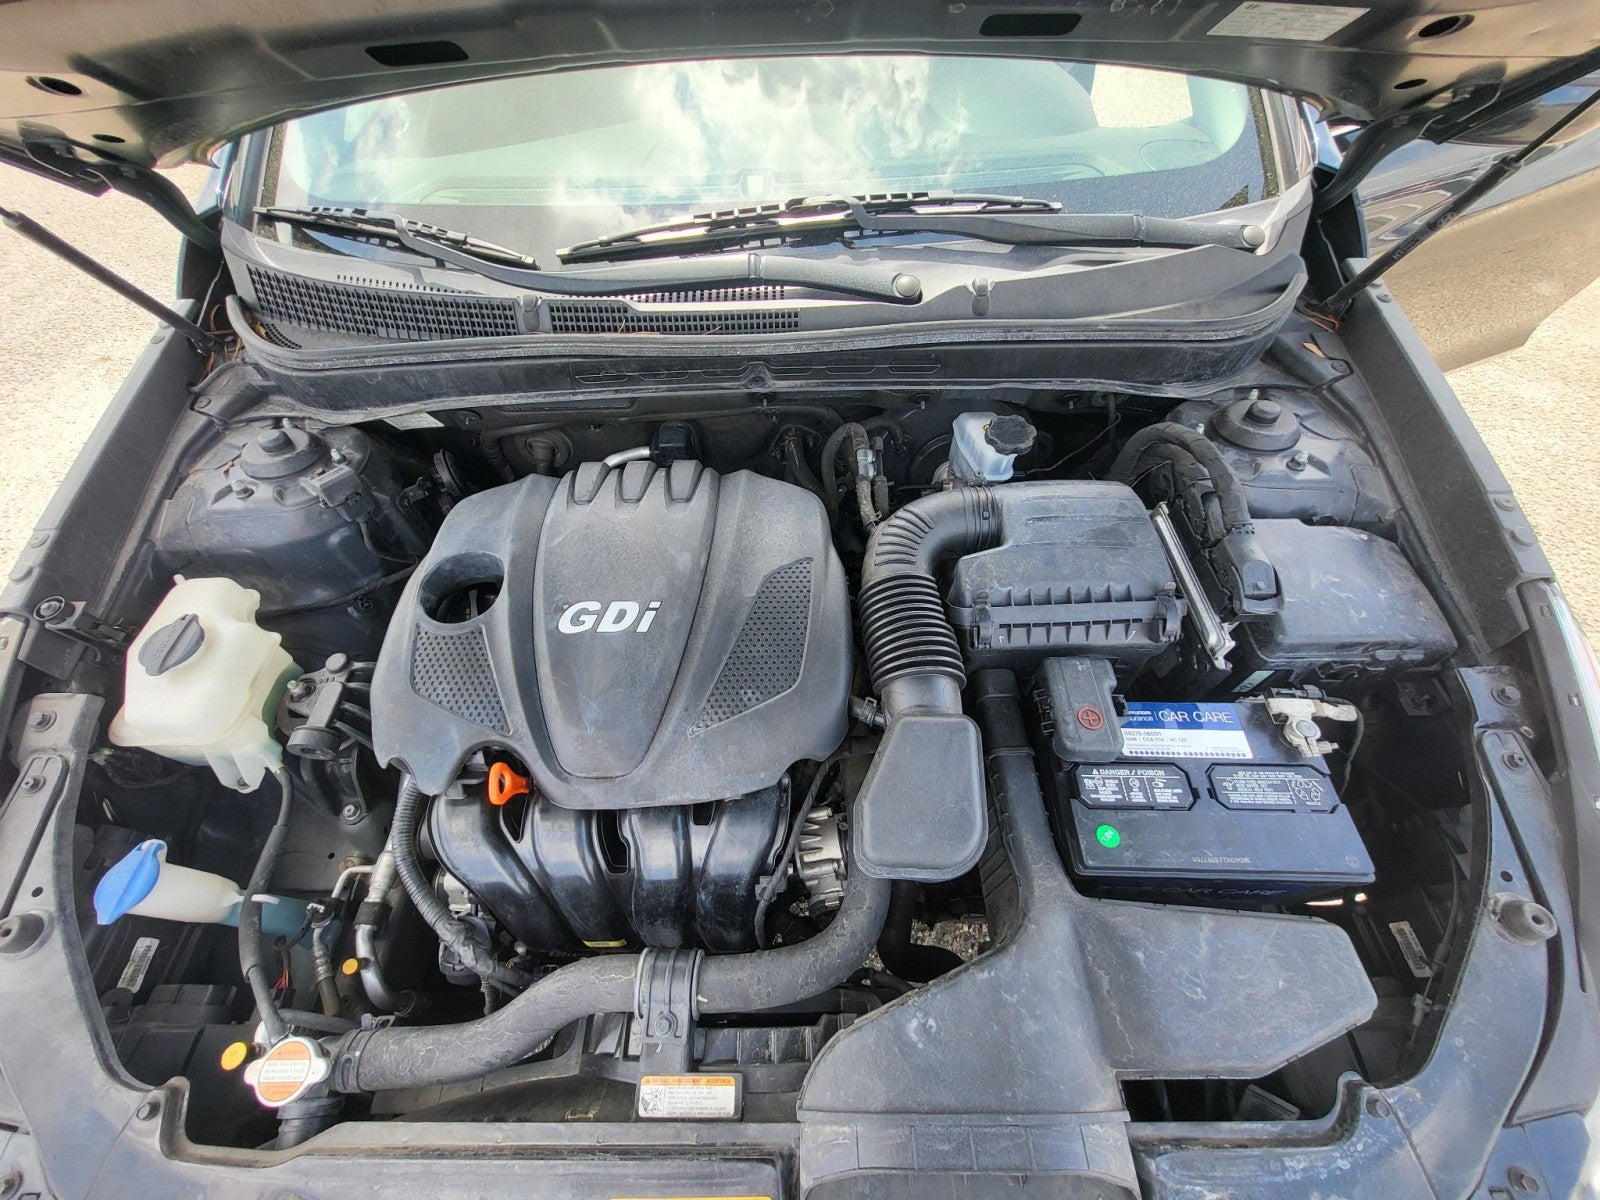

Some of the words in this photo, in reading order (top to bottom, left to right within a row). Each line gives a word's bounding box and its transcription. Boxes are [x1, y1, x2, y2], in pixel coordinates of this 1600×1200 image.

[558, 601, 662, 634] GDi
[1158, 711, 1190, 722] CAR
[1192, 711, 1234, 724] CARE
[1099, 768, 1131, 776] DANGER
